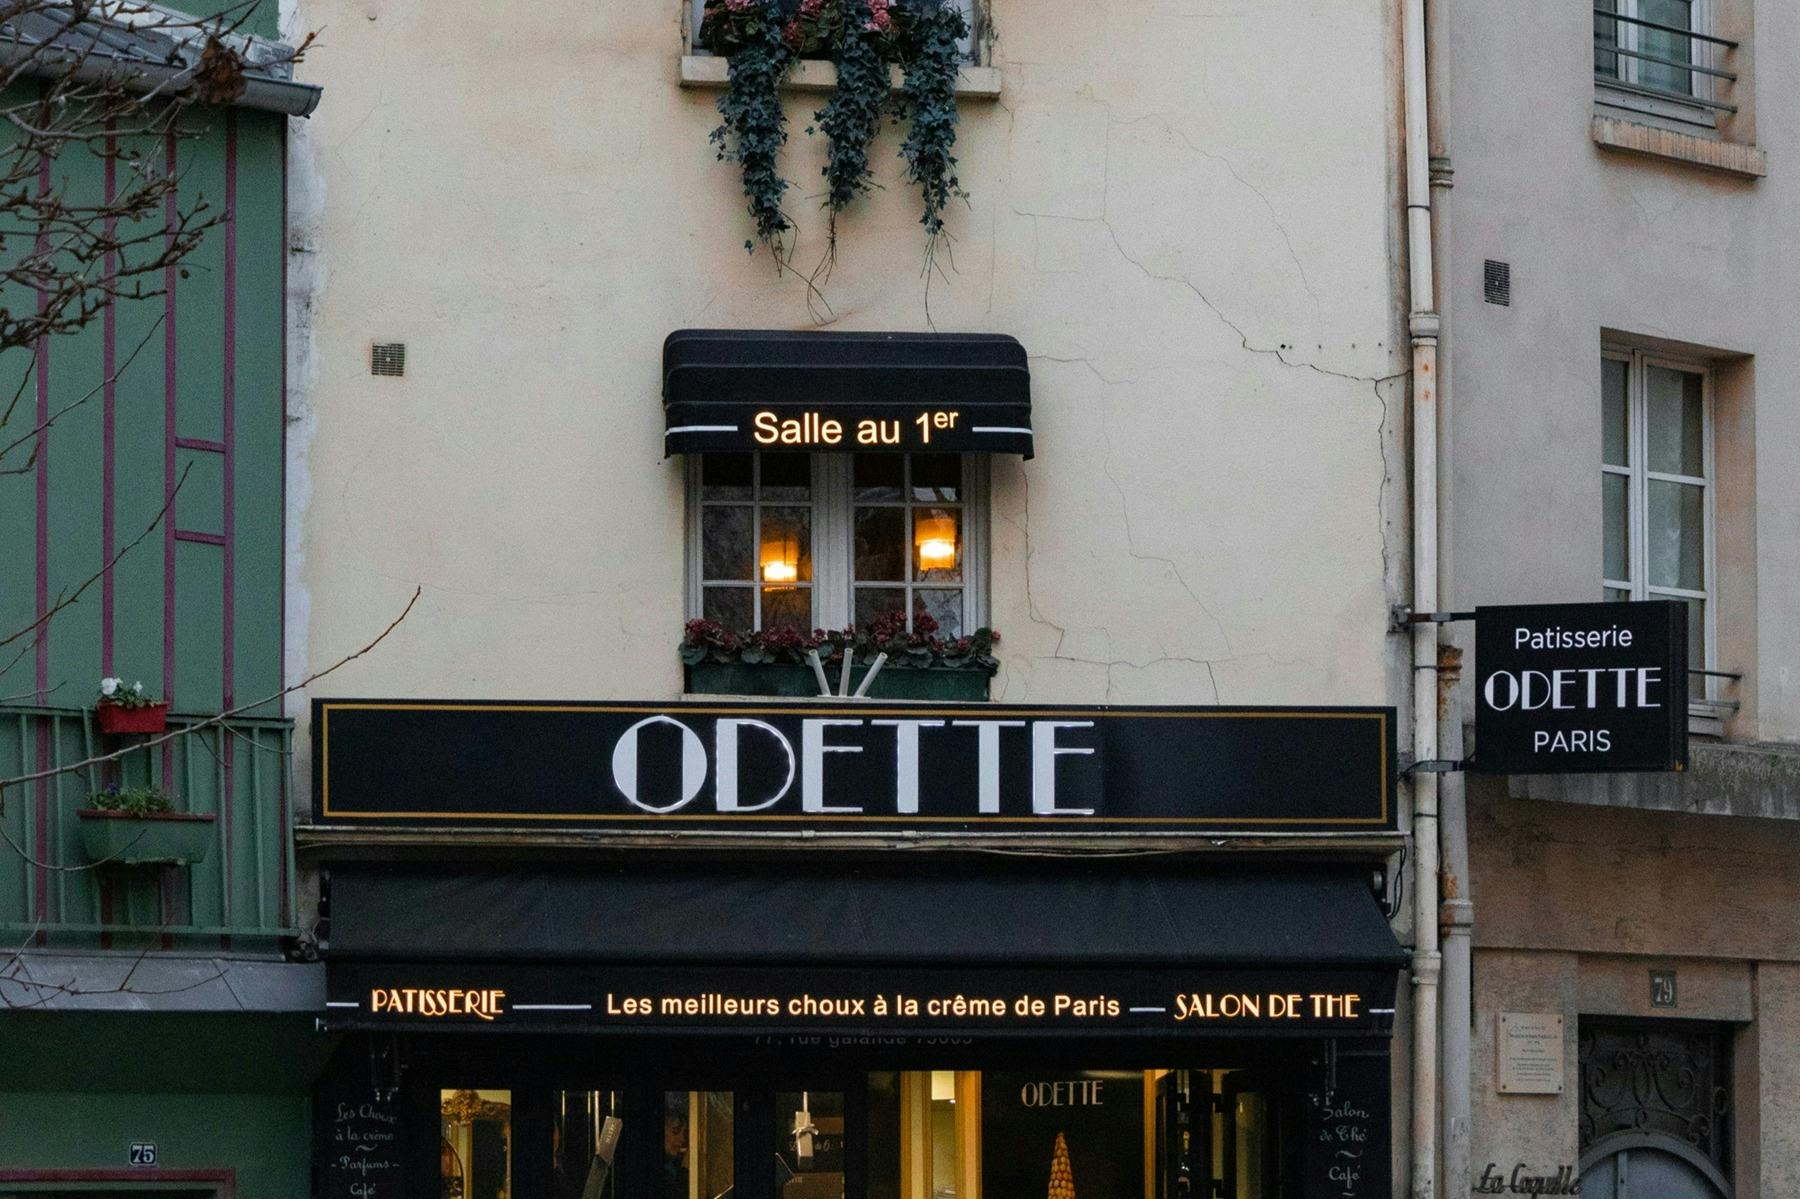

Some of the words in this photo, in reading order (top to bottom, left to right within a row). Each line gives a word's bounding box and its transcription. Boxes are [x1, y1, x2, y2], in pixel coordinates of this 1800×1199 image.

[753, 412, 842, 444] Salle
[857, 420, 900, 444] au
[915, 411, 959, 444] 1er
[1515, 625, 1633, 650] Patisserie
[1484, 667, 1662, 712] ODETTE
[1534, 730, 1611, 753] PARIS
[611, 714, 1096, 816] ODETTE
[1654, 977, 1673, 1003] 79
[370, 989, 506, 1021] PATISSERIE
[606, 994, 653, 1016] Les
[661, 994, 780, 1016] meilleurs
[787, 994, 865, 1016] choux
[873, 994, 888, 1017] à
[896, 994, 919, 1017] la
[927, 994, 1007, 1017] crême
[1014, 994, 1046, 1017] de
[1054, 994, 1121, 1018] Paris
[1173, 993, 1260, 1021] SALON
[1268, 993, 1303, 1019] DE
[1309, 993, 1361, 1019] THE
[1021, 1079, 1104, 1107] ODETTE
[335, 1102, 356, 1122] Les
[1321, 1101, 1369, 1120] Salon
[132, 1144, 154, 1163] 75
[1328, 1165, 1361, 1189] Café
